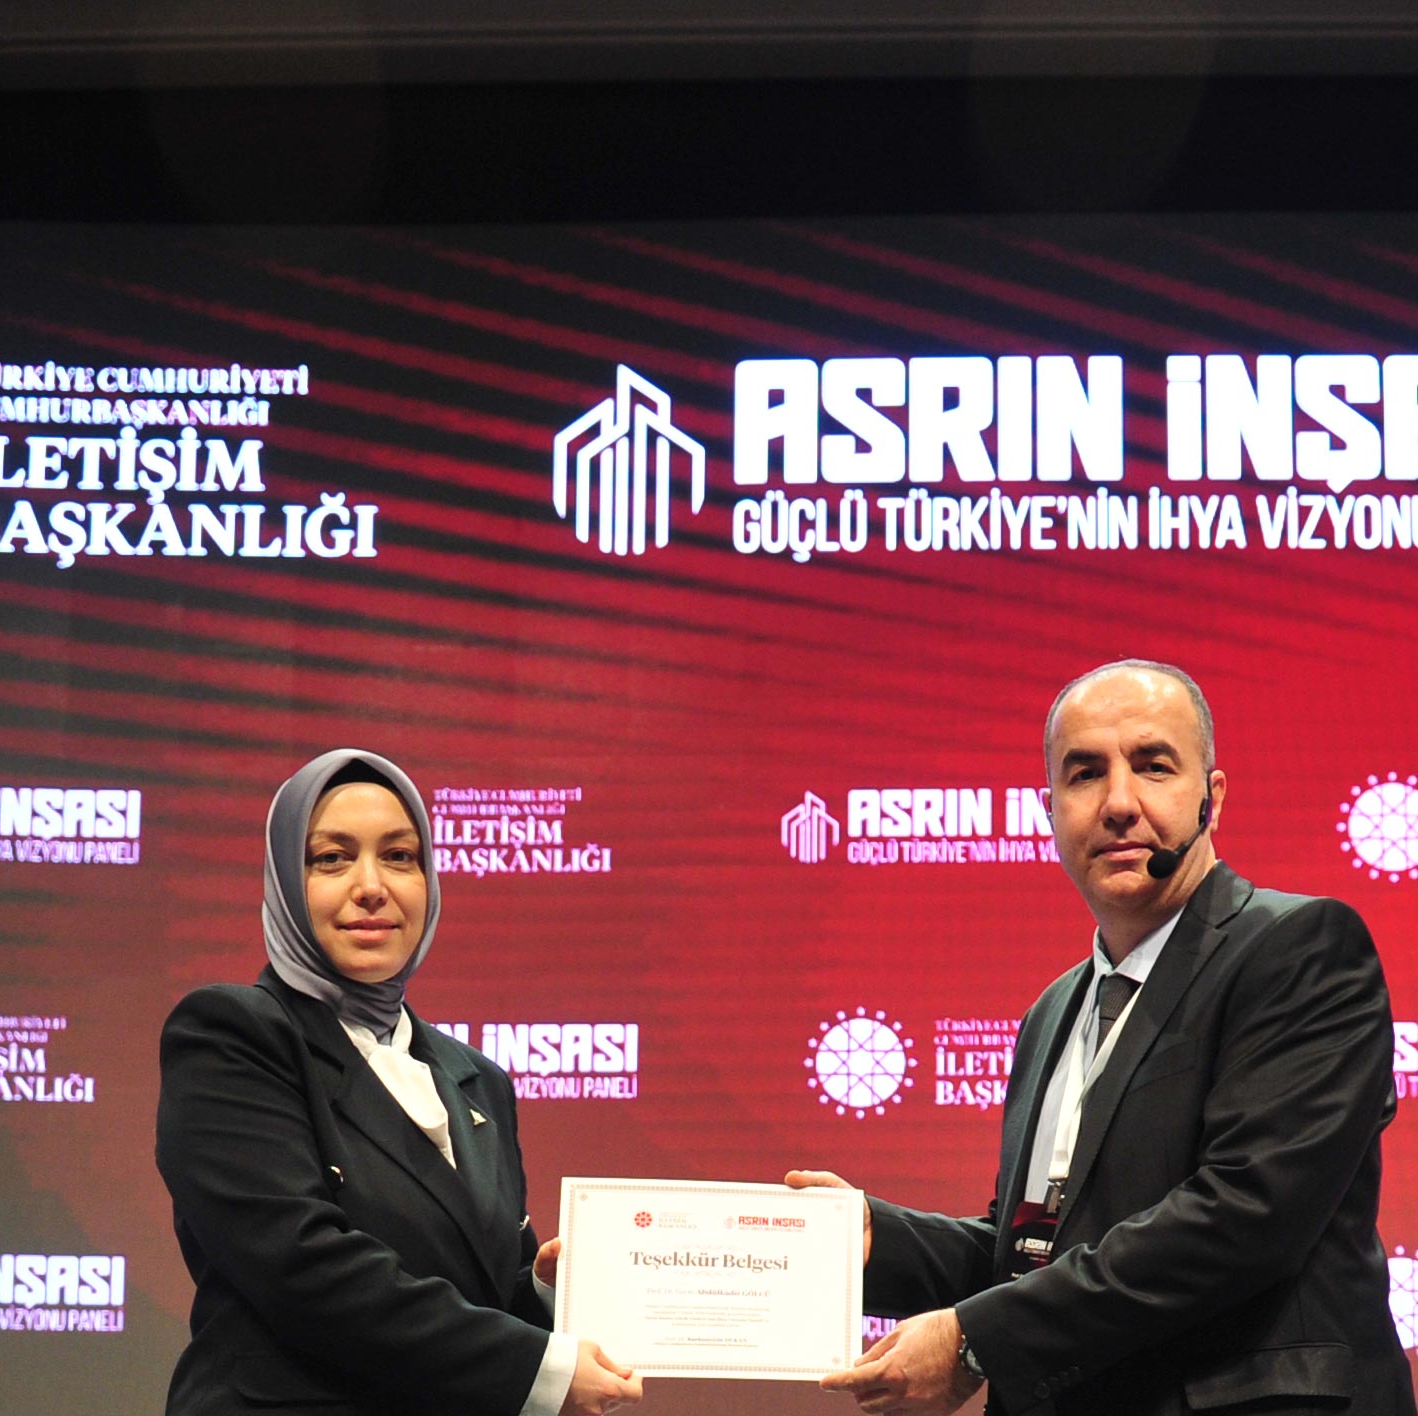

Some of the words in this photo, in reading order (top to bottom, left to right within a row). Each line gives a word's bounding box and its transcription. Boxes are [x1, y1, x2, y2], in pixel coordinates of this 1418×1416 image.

[96, 362, 309, 396] CUMHURİYETİ
[732, 355, 1124, 485] ASRIN
[732, 491, 867, 563] GÜÇLÜ
[876, 487, 1137, 553] TÜRKİYE'NİN
[1148, 486, 1246, 550] İHYA
[847, 788, 992, 838] ASRIN
[433, 814, 564, 848] İLETİŞİM
[433, 844, 612, 877] BAŞKANLIĞI
[482, 1024, 638, 1077] İNŞASI
[935, 1047, 1014, 1076] İLETİ
[630, 1251, 719, 1270] Teşekkür
[723, 1254, 789, 1273] Belgesi
